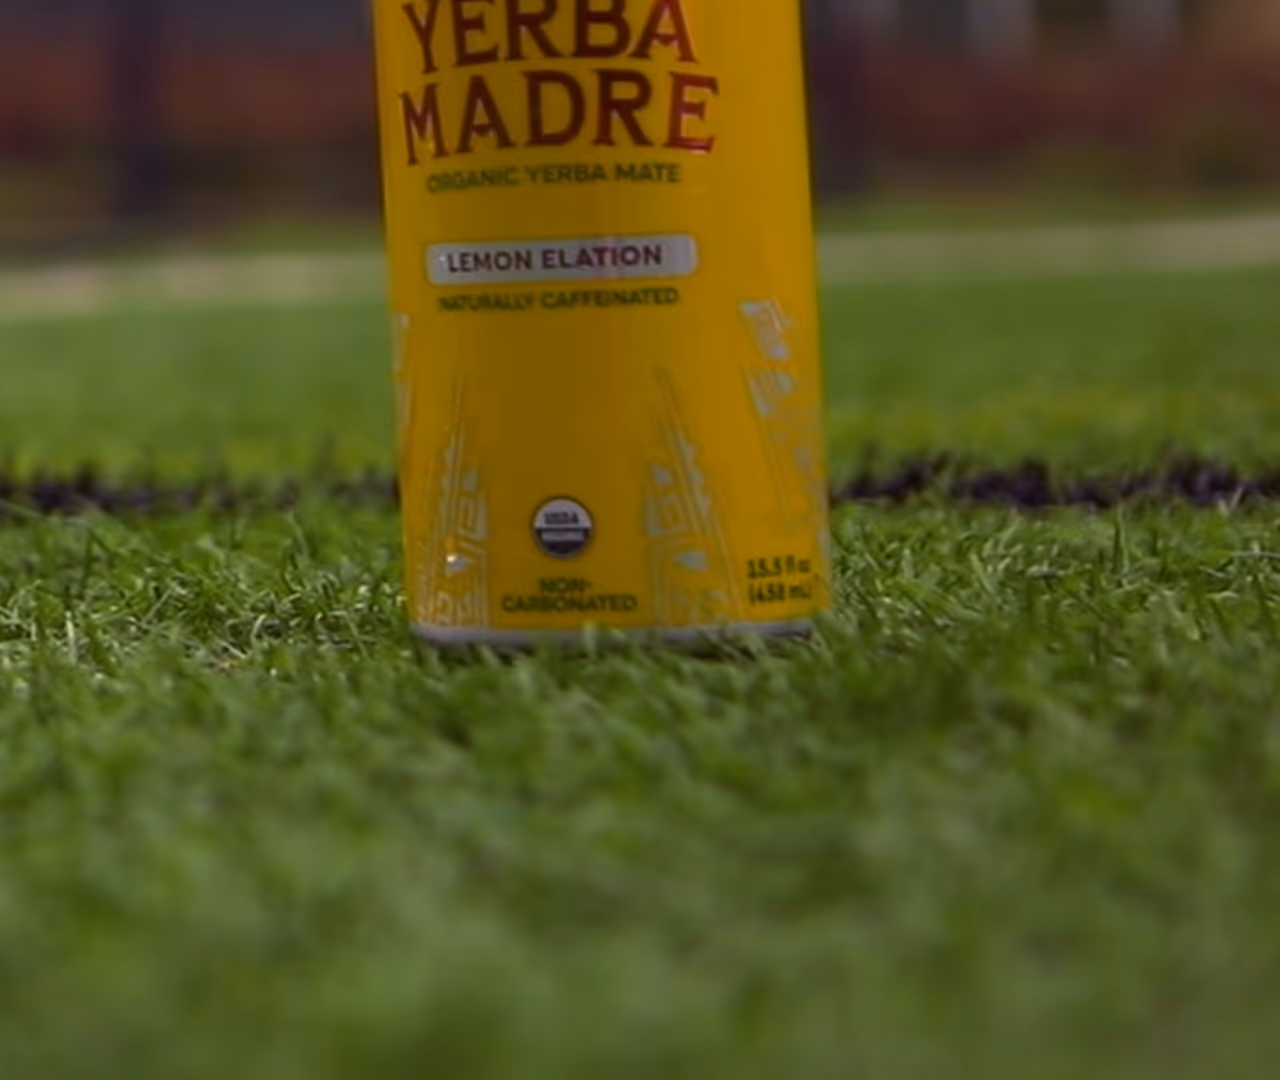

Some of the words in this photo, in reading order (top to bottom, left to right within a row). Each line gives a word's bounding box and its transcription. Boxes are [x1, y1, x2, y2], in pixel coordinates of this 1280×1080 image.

[398, 68, 720, 167] MADRE
[426, 167, 518, 193] ORGANIC
[525, 164, 607, 185] YERBA
[615, 163, 681, 183] MATE
[447, 250, 534, 273] LEMON
[541, 244, 664, 270] ELATION
[438, 291, 535, 311] NATURALLY
[540, 287, 680, 309] CAFFEINATED
[540, 577, 592, 593] NON-
[501, 594, 639, 612] CARBONATED
